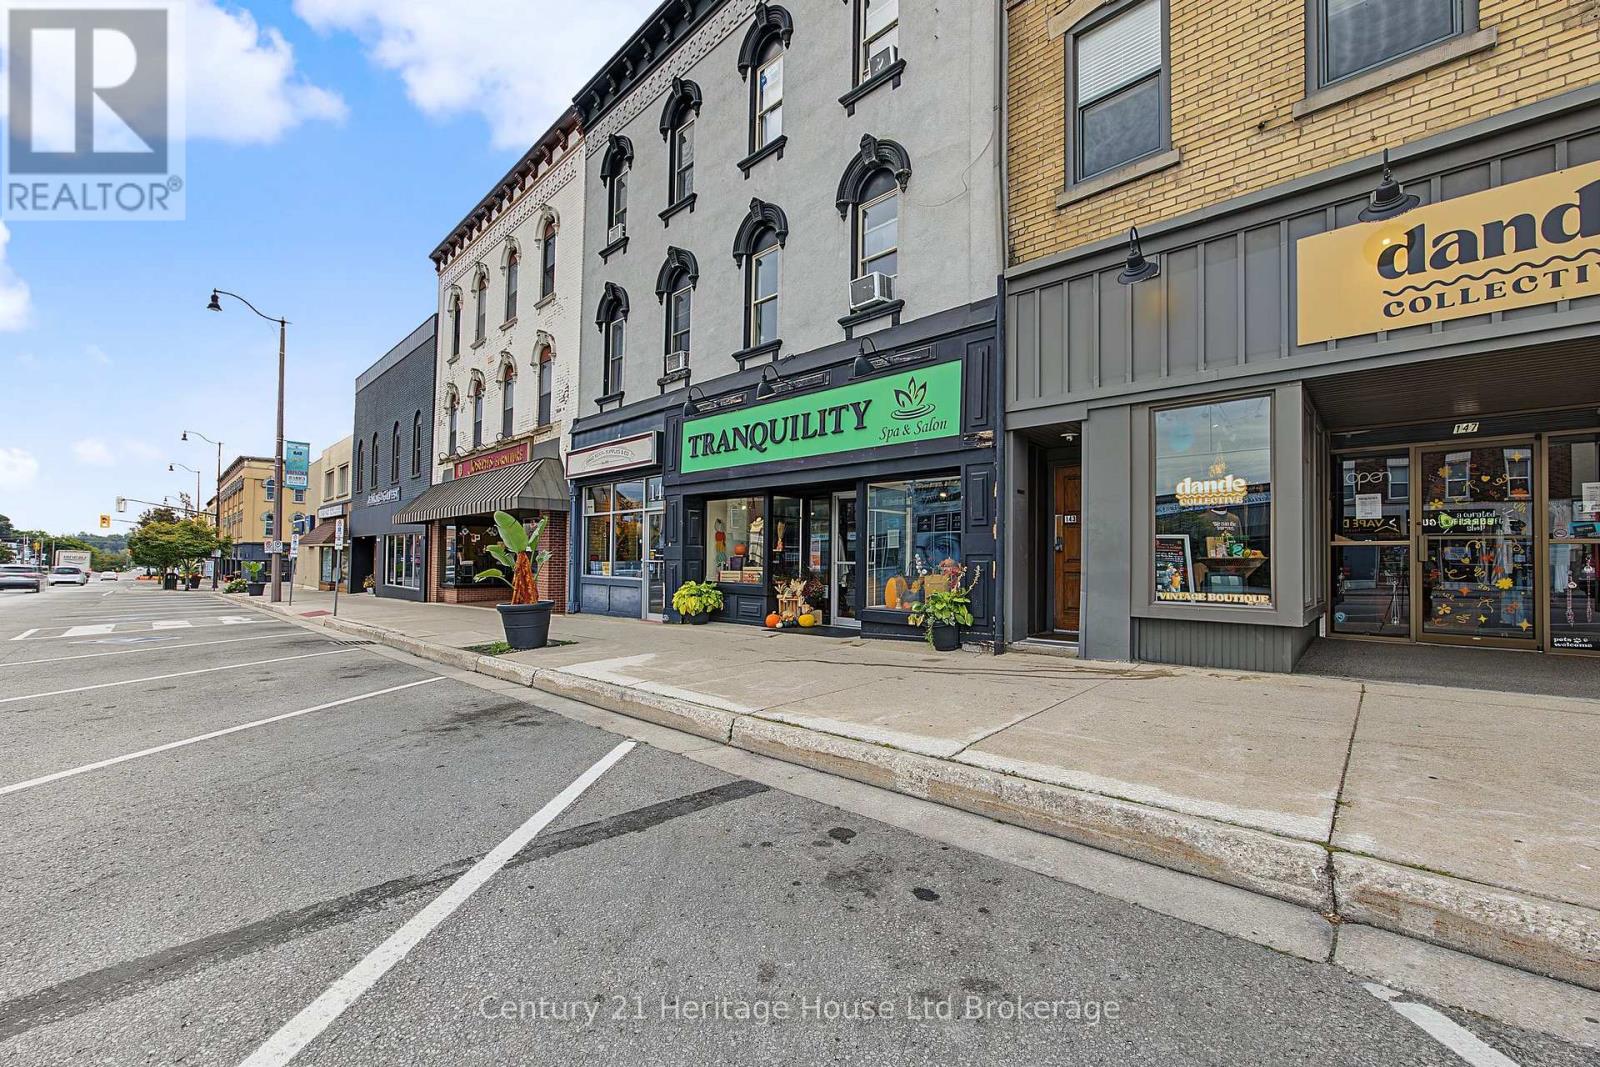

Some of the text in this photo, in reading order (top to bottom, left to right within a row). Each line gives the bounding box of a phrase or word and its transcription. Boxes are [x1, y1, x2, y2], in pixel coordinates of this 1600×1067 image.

[1383, 262, 1600, 318] COLLECTI
[688, 399, 873, 458] TRANQUILITY
[879, 417, 947, 443] Spa & Salon
[1455, 422, 1478, 433] 147
[1176, 474, 1247, 493] dande
[1346, 472, 1391, 491] open
[1179, 495, 1243, 506] COLLECTIVE
[1160, 591, 1270, 605] VINTAGE BOUTIQUE
